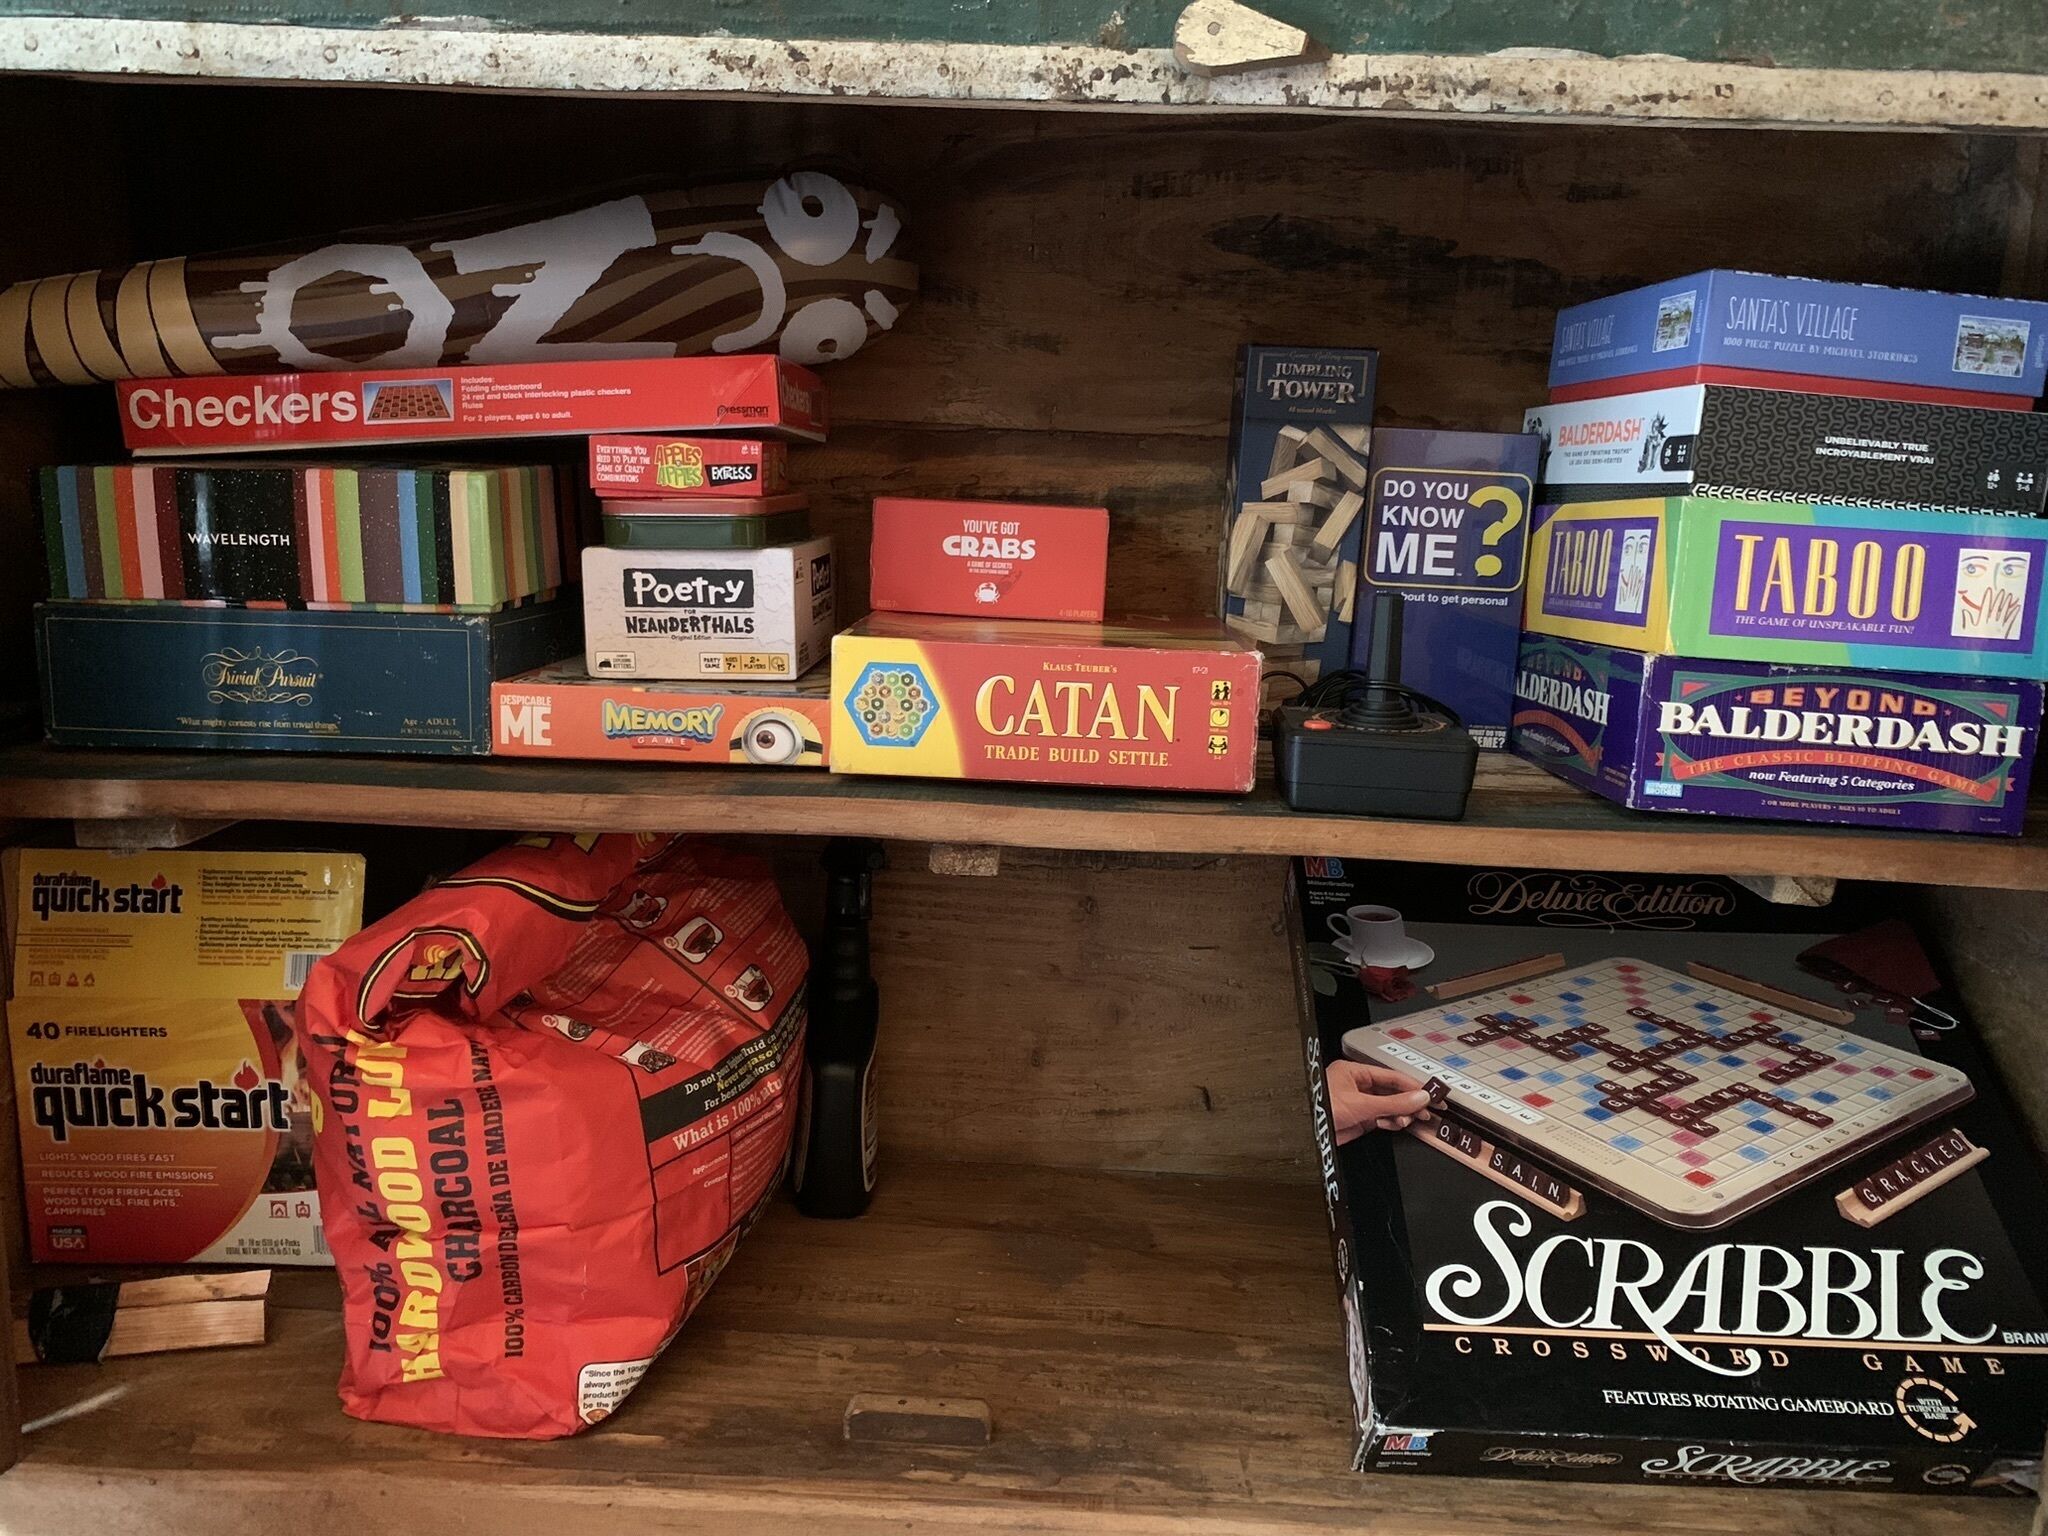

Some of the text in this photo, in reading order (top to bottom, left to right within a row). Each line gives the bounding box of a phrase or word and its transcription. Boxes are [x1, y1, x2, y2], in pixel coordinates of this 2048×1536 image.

[1726, 296, 1790, 335] SANTA'S
[1797, 303, 1859, 341] VILLAGE
[1723, 337, 1918, 364] 1000 PIECE PUZZLE BY MICHAEL STORRINGS
[460, 376, 495, 385] Includes:
[1272, 362, 1352, 379] JUMBLING
[461, 382, 542, 393] Folding checkerboard
[486, 392, 501, 400] and
[502, 391, 523, 399] black
[524, 389, 569, 399] interlocking
[570, 388, 597, 398] plastic
[597, 388, 632, 396] checkers
[1267, 379, 1356, 404] TOWER
[129, 386, 358, 430] Checkers
[462, 401, 484, 409] Rules
[717, 405, 769, 417] pressman
[463, 411, 573, 422] For players, ages to adult.
[1558, 417, 1642, 448] BALDERDASH
[596, 444, 647, 456] EVERYTHING YOU
[1825, 436, 1929, 452] UNBELIEVABLY TRUE
[596, 454, 650, 464] NEED PLAY THE
[654, 445, 703, 466] APPLES
[1816, 447, 1935, 465] INCROYABLEMENT VRAI
[596, 463, 645, 474] GAME CRAZY
[596, 473, 640, 483] COMBINATIONS
[656, 466, 703, 487] APPLES
[711, 466, 753, 480] EXPRESS
[1384, 479, 1469, 500] DO YOU
[963, 520, 1020, 535] YOU'VE GOT
[1381, 505, 1465, 529] KNOW
[187, 533, 290, 546] WAVELENGTH
[942, 535, 1036, 560] CRABS
[1375, 532, 1457, 577] ME
[1551, 528, 1613, 598] TABOO
[632, 571, 744, 605] Poetry
[1735, 535, 1926, 622] TABOO
[1428, 593, 1509, 607] to get personal
[624, 616, 755, 634] NEANDERTHALS
[1735, 616, 1915, 635] THE GAME OF UNSPEAKABLE FUN!
[202, 661, 317, 688] Trivial Pursuit
[1043, 661, 1118, 674] KLAUS TEUBER'S
[500, 694, 552, 706] DESPICABLE
[975, 675, 1181, 743] CATAN
[1749, 686, 1937, 716] BEYOND
[202, 718, 313, 729] mighty contests from trivial
[426, 718, 456, 726] ADULT
[500, 705, 552, 746] ME
[605, 700, 721, 736] MEMORY
[1656, 701, 2025, 758] BALDERDASH
[637, 736, 687, 745] GAME
[984, 744, 1169, 767] TRADE BUILD SETTLE
[1687, 751, 1979, 795] THE CLASSIC BLUFFING GAME
[1749, 771, 1915, 791] now Featuring 5 Categories
[1801, 802, 1831, 810] PLAYERS
[1304, 857, 1344, 878] MB
[33, 872, 93, 886] duraflame
[32, 879, 110, 921] quick
[113, 883, 184, 913] start
[1467, 870, 1732, 916] Deluxe Edition
[27, 1022, 168, 1040] 40 FIRELIGHTERS
[31, 1062, 131, 1085] duraflame
[716, 1071, 739, 1092] Never
[684, 1073, 716, 1096] Do not
[32, 1074, 290, 1141] quick start
[704, 1086, 738, 1112] For best
[477, 1085, 507, 1155] MADERE
[672, 1092, 762, 1151] What is 100%
[1307, 1036, 1340, 1204] SCRABBLE
[1772, 1107, 1893, 1168] SCRABBLE
[39, 1153, 176, 1162] LIGHTS WOOD FIRES FAST
[41, 1170, 214, 1180] REDUCES WOOD FIRE EMISSIONS
[488, 1160, 511, 1186] DE
[43, 1187, 114, 1196] PERFECT FOR
[427, 1097, 483, 1282] CHARCOAL
[43, 1198, 151, 1206] WOOD FIRE
[45, 1207, 106, 1216] CAMPFIRES
[53, 1237, 85, 1248] USA
[497, 1254, 523, 1306] CARBÓN
[1425, 1200, 1997, 1377] SCRABBLE
[363, 1261, 402, 1353] 100%
[503, 1308, 525, 1359] 100%
[1454, 1336, 2006, 1376] CROSSWORD GAME
[613, 1368, 625, 1377] the
[583, 1391, 619, 1400] products
[584, 1381, 611, 1390] always
[1602, 1389, 1895, 1416] FEATURES ROTATING GAMEBOARD
[1906, 1404, 1960, 1414] TURNTABLE
[1917, 1397, 1943, 1406] WITH
[1923, 1412, 1949, 1420] BASE
[1384, 1434, 1429, 1451] MB
[1641, 1445, 1891, 1484] SCRABBLE
